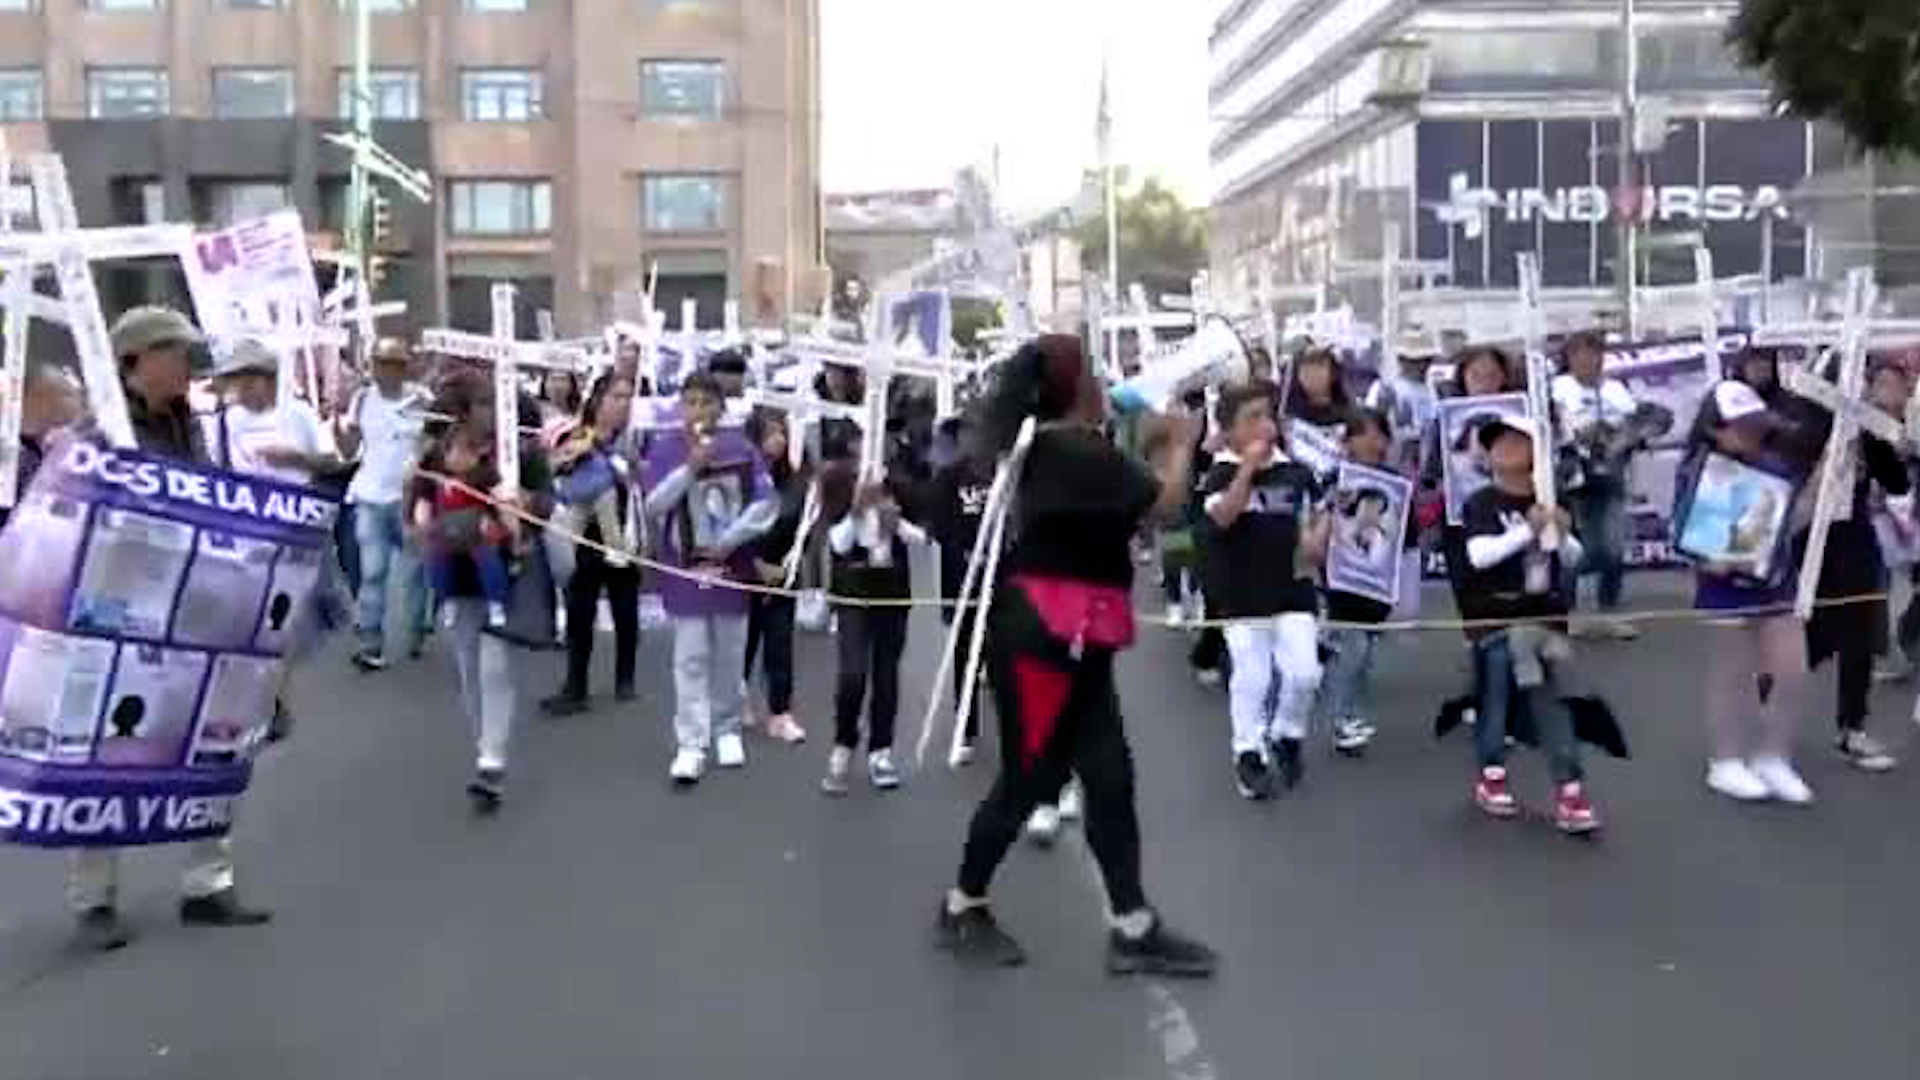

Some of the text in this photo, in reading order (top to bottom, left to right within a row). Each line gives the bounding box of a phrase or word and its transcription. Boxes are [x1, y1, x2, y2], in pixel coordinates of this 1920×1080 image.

[166, 469, 211, 503] DE
[215, 480, 257, 517] LA
[137, 796, 161, 832] Y
